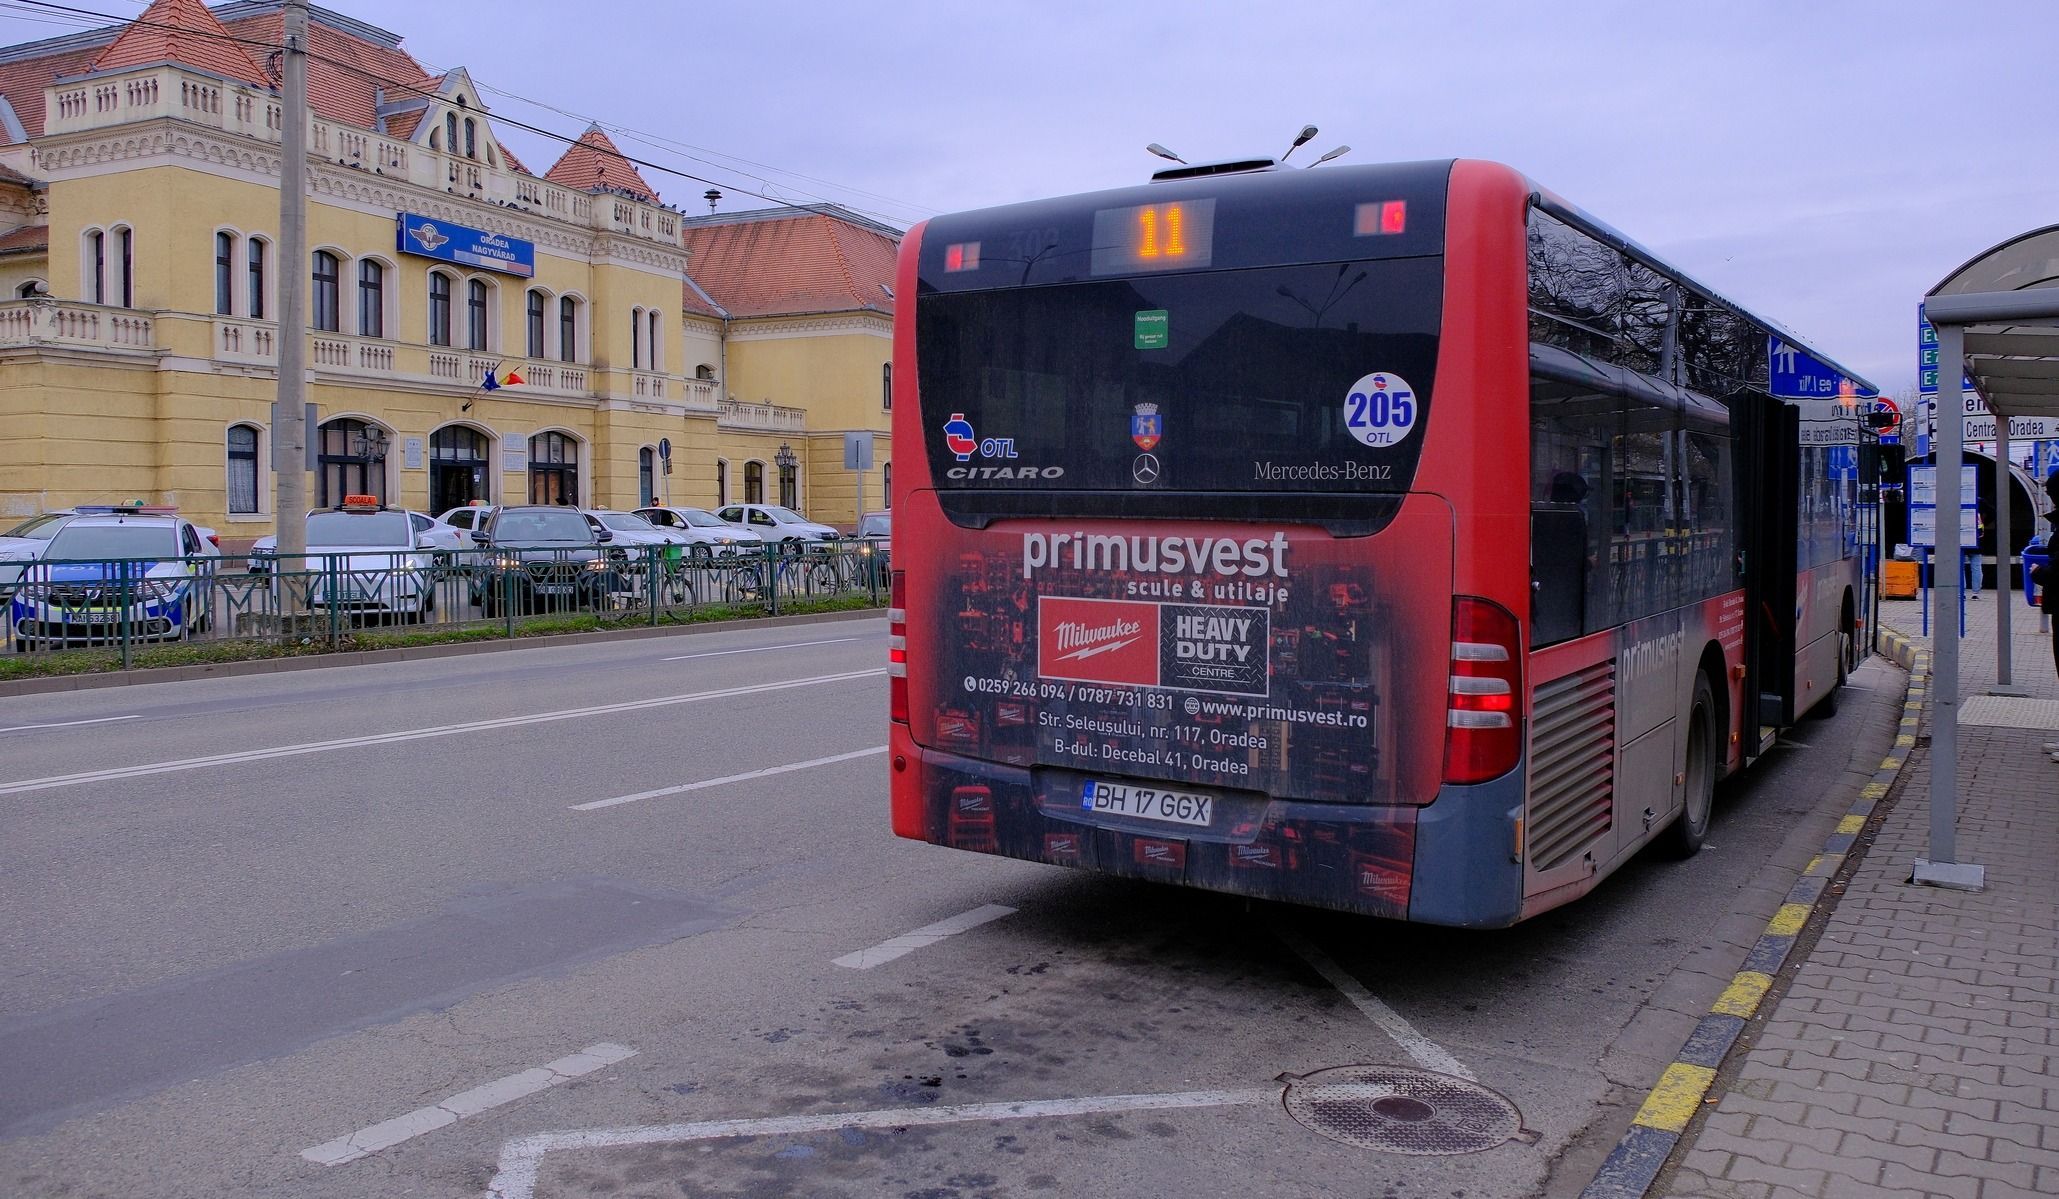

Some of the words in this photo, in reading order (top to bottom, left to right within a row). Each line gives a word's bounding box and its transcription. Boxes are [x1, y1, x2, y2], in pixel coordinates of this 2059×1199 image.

[480, 235, 509, 249] ORADEA
[1139, 207, 1184, 256] 11
[472, 244, 515, 261] NAGYVÁRAD
[1348, 391, 1412, 428] 205
[1366, 432, 1393, 443] OTL
[2008, 418, 2044, 436] Oradea
[980, 437, 1019, 458] OTL
[946, 466, 1065, 479] CITARO
[1254, 460, 1392, 480] Mercedes-Benz
[1023, 531, 1289, 579] primusvest
[1127, 580, 1182, 597] scule
[1191, 580, 1205, 598] &
[1214, 580, 1289, 606] utilaje
[1052, 618, 1142, 651] Milwaukee
[1176, 615, 1251, 642] HEAVY
[1176, 641, 1251, 662] DUTY
[1192, 666, 1235, 679] CENTRE
[978, 678, 1009, 694] 0259
[1013, 682, 1037, 698] 266
[1040, 684, 1065, 700] 094
[1068, 685, 1075, 702] /
[1078, 688, 1112, 705] 0787
[1116, 690, 1142, 707] 731
[1147, 694, 1173, 710] 831
[1202, 701, 1368, 728] www.primusvest.ro
[1039, 712, 1062, 728] Str.
[1150, 725, 1169, 740] nr.
[1174, 725, 1206, 745] 117,
[1210, 729, 1267, 750] Oradea
[1102, 744, 1161, 766] Decebal
[1164, 752, 1188, 771] 41,
[1192, 755, 1249, 775] Oradea
[1082, 797, 1093, 808] RO
[1095, 785, 1127, 811] BH
[1135, 790, 1156, 814] 17
[1160, 793, 1209, 822] GGX
